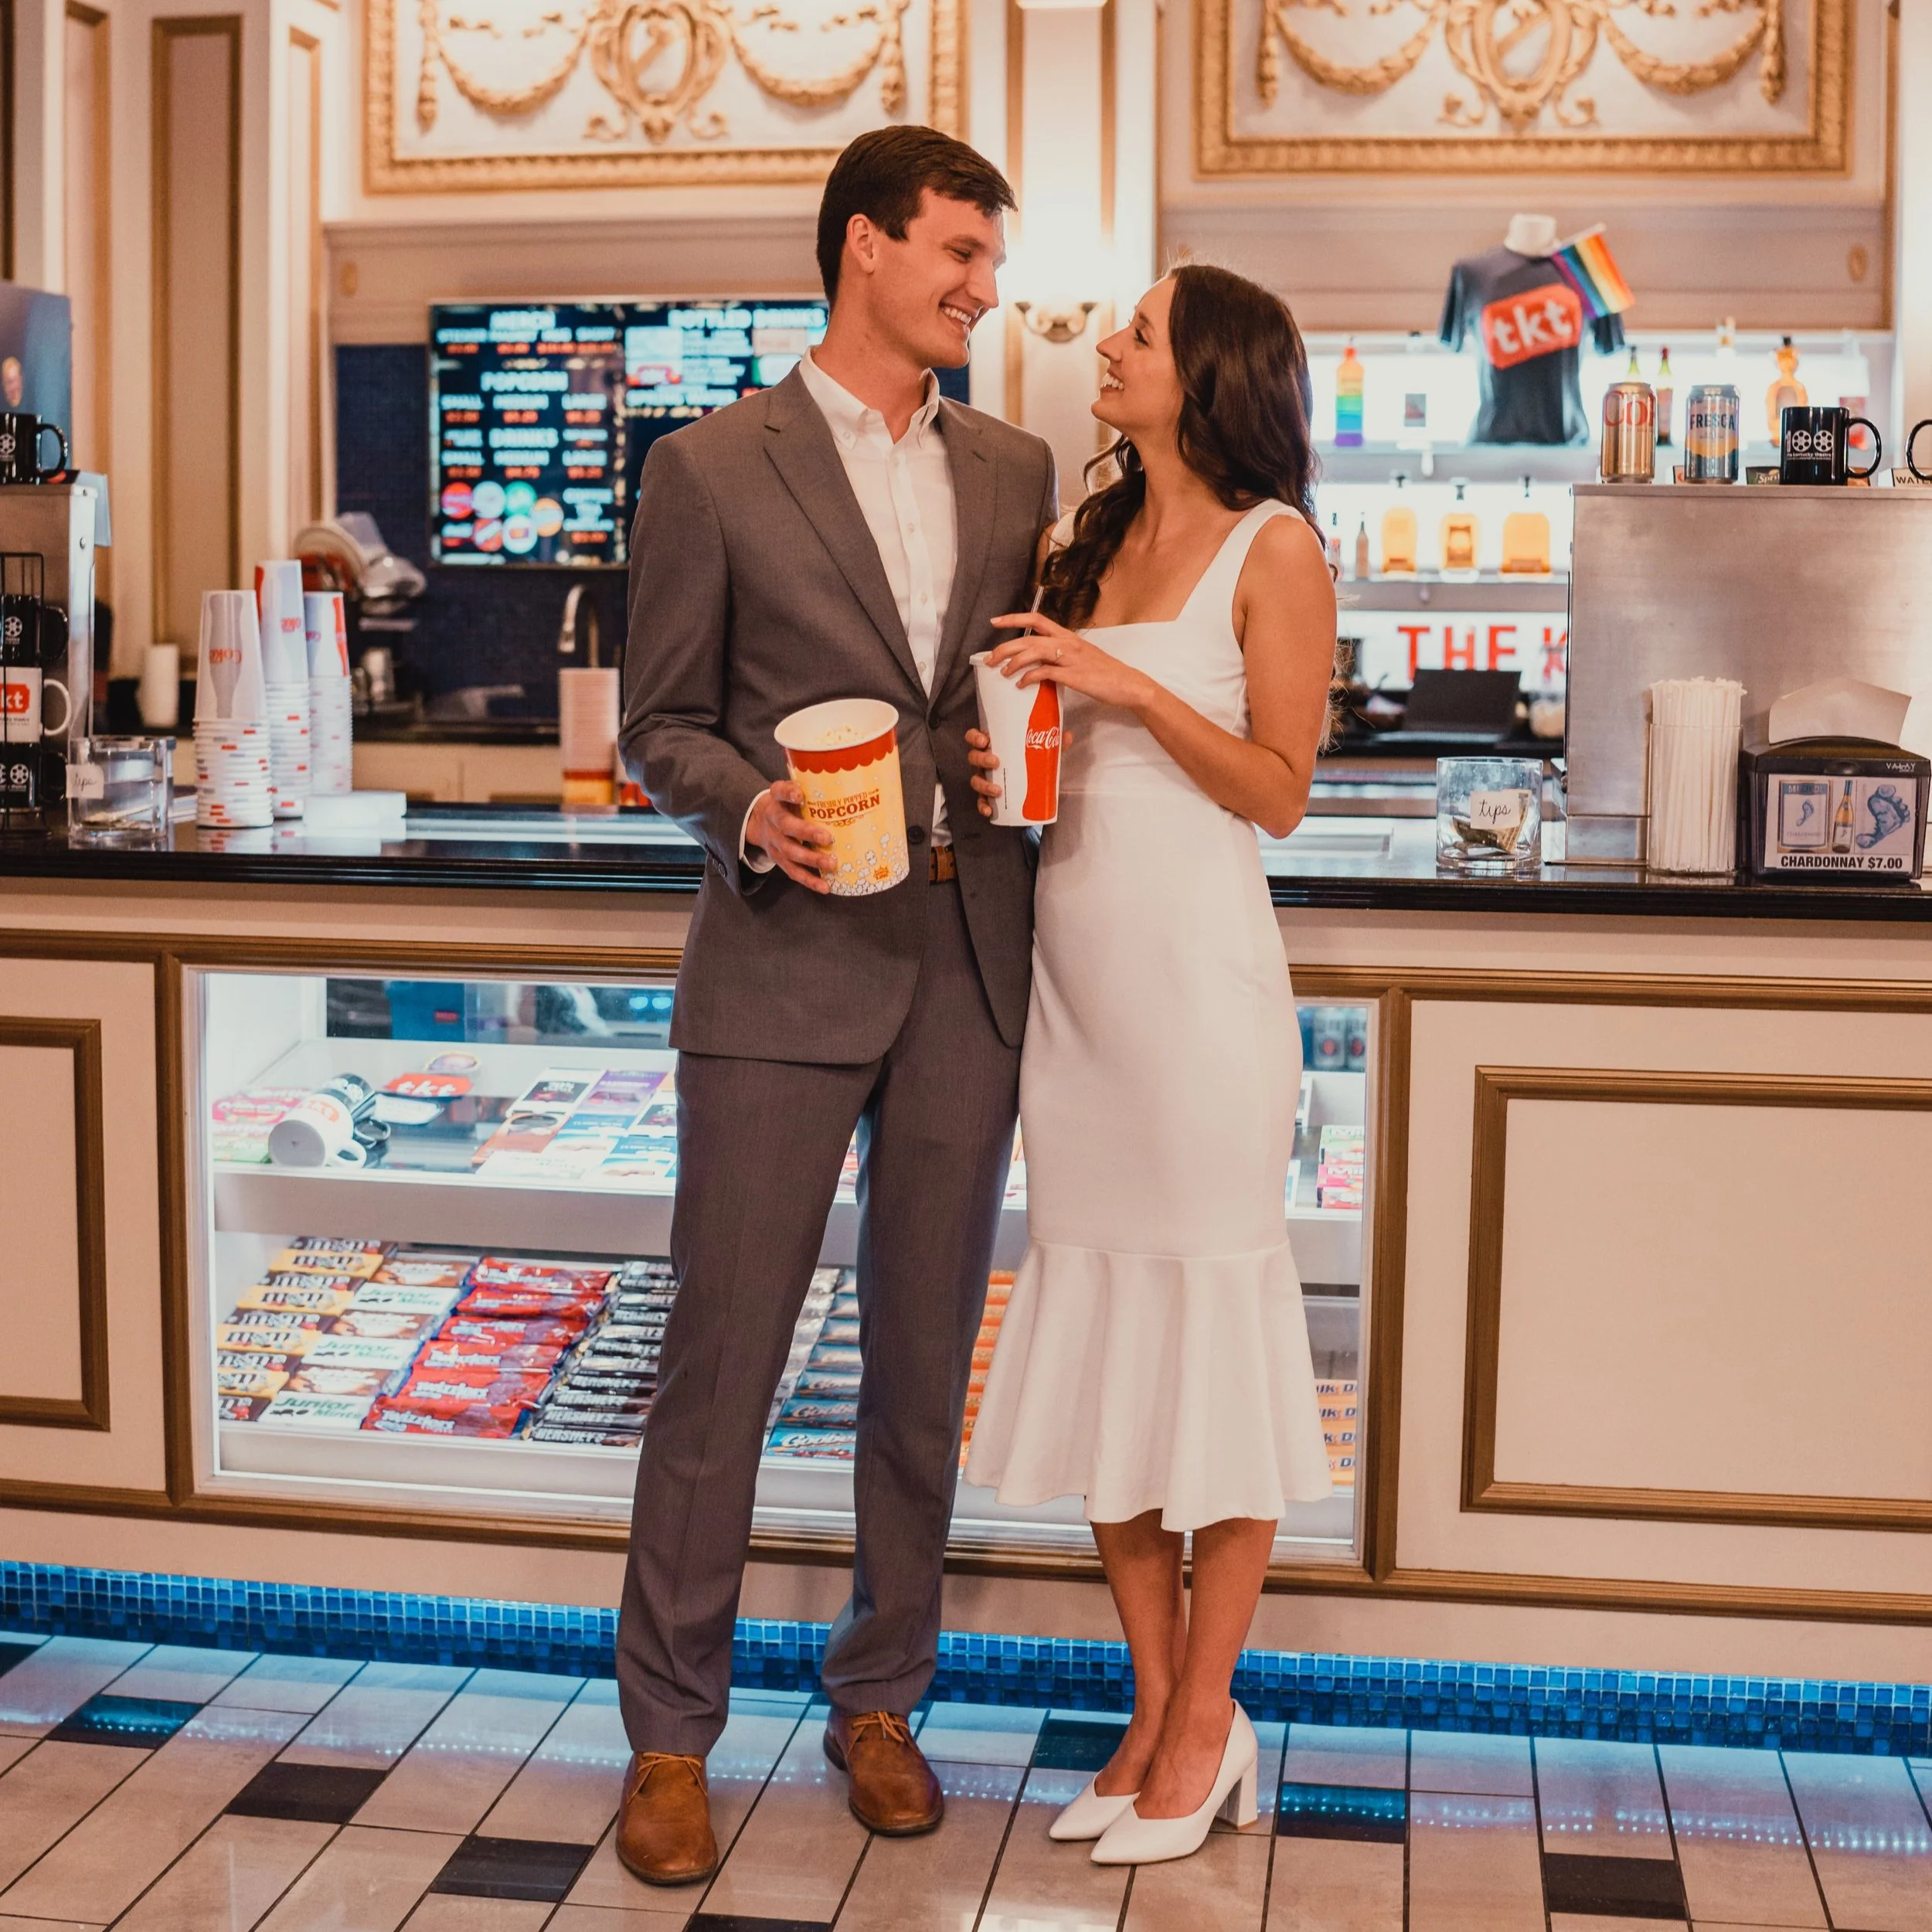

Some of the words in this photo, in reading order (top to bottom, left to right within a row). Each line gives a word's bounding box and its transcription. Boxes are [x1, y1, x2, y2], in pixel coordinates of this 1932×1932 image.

[1493, 296, 1573, 355] tkt
[1690, 413, 1735, 430] FRESCA
[843, 791, 868, 804] POPPED
[809, 794, 880, 819] POPCORN
[1478, 799, 1512, 825] tips
[1781, 855, 1864, 869] CHARDONNAY
[1867, 857, 1903, 870] $7.00
[274, 1397, 355, 1409] Junior
[313, 1409, 362, 1419] Mints
[544, 1410, 615, 1423] HERSHEY'S
[535, 1427, 607, 1444] HERSHEY'S
